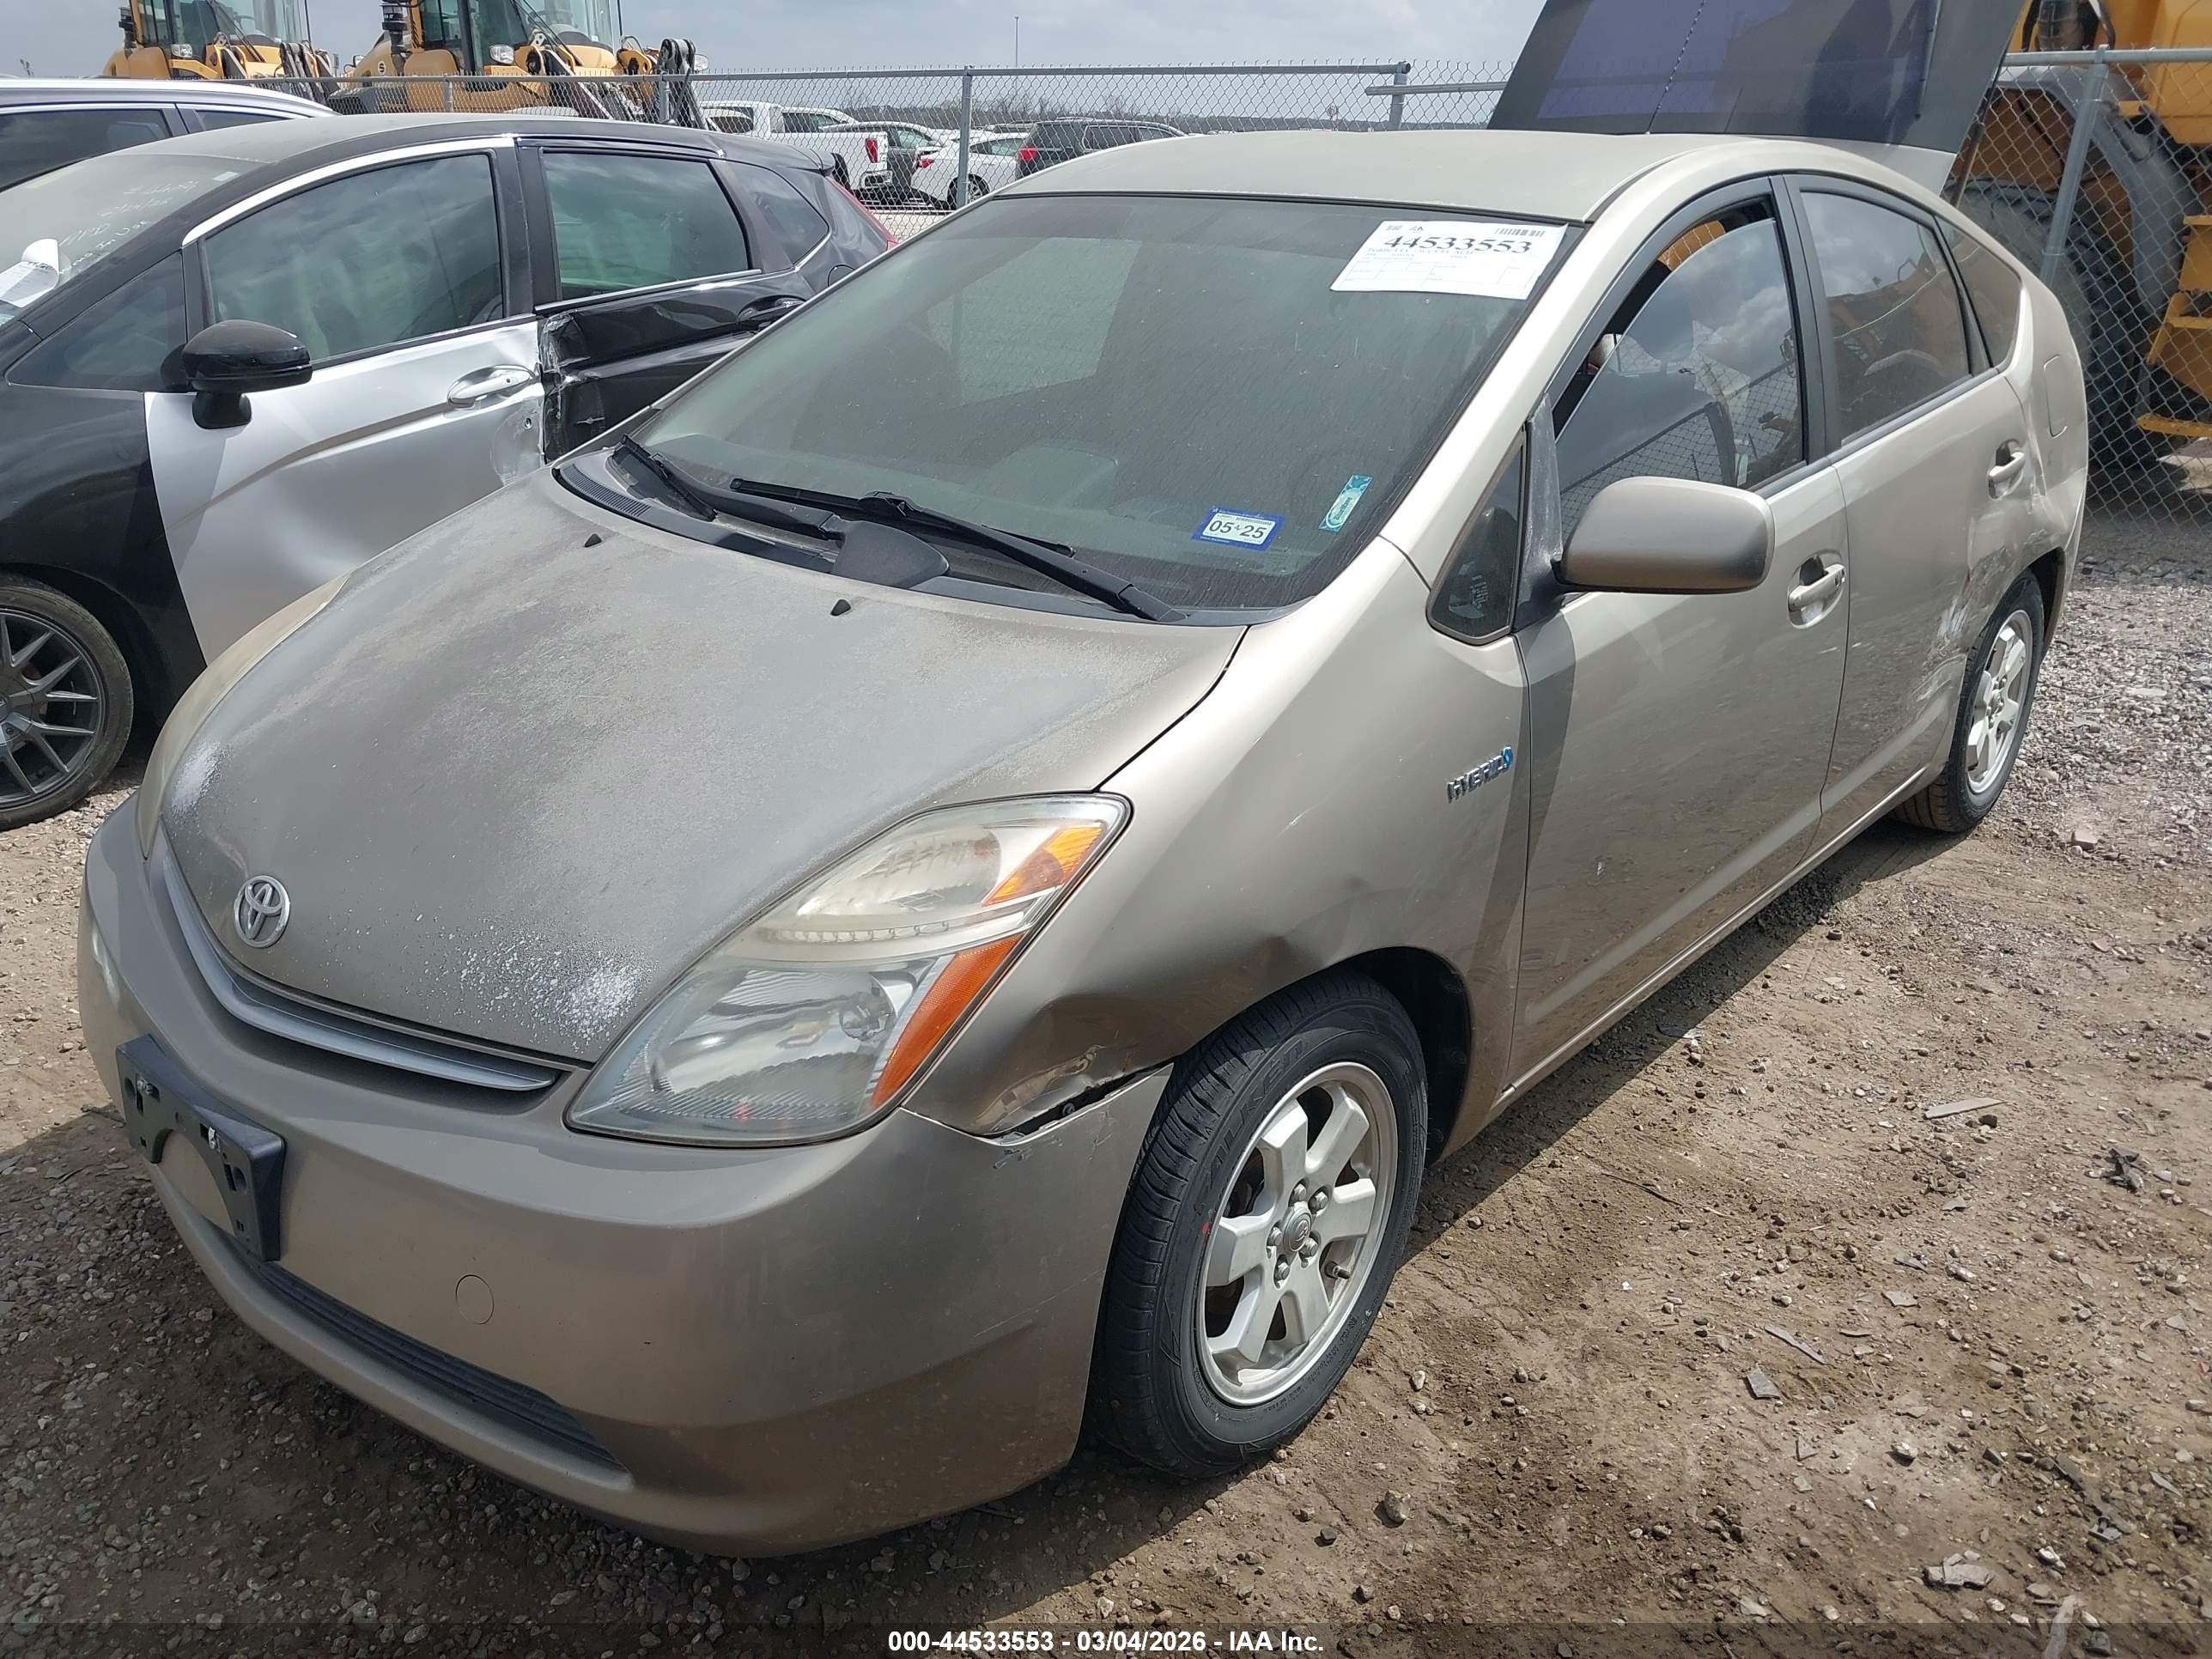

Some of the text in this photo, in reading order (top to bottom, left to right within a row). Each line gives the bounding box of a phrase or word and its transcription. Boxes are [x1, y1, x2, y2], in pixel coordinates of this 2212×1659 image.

[1384, 235, 1533, 253] 44533553
[1209, 520, 1233, 533] 05
[1239, 525, 1267, 539] 25
